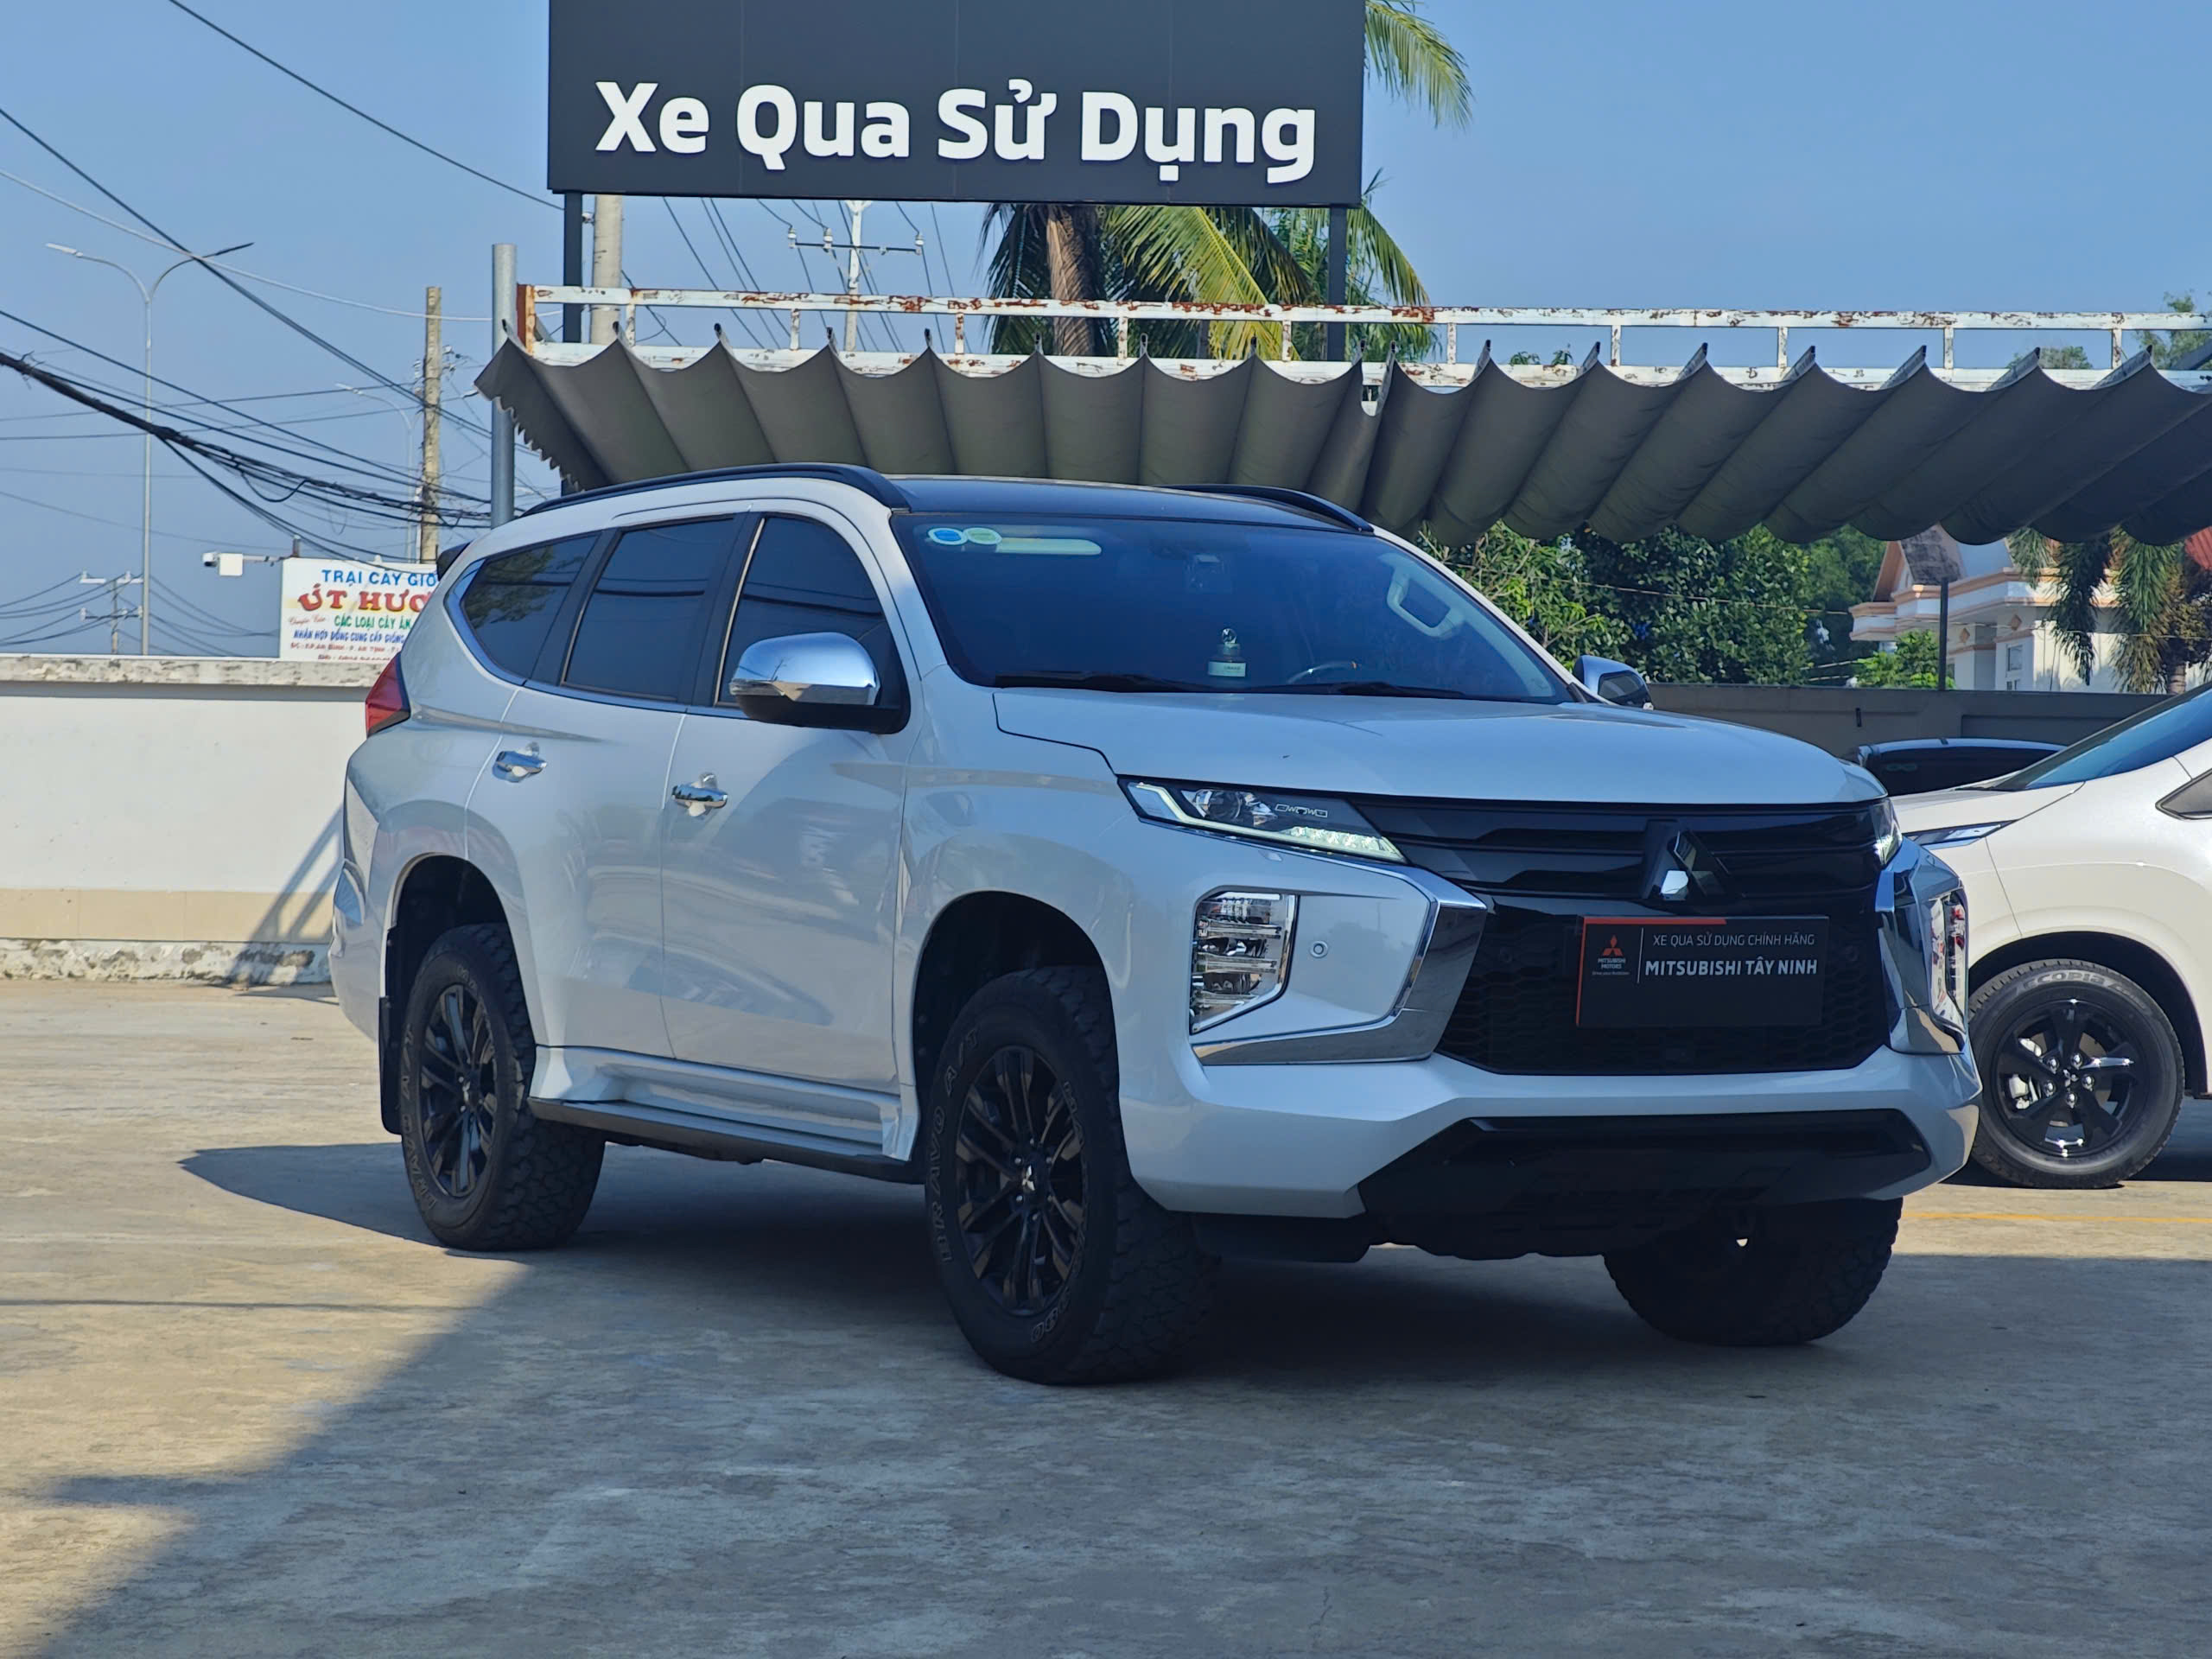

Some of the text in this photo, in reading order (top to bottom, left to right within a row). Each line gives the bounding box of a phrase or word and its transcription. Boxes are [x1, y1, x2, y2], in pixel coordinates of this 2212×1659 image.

[594, 79, 1316, 185] Xe Qua Sử Dụng
[1652, 934, 1668, 946] XE
[1670, 934, 1694, 948] QUA
[1714, 934, 1745, 949] DỤNG
[1747, 931, 1782, 946] CHÍNH
[1644, 956, 1818, 976] MITSUBISHI TÂY NINH
